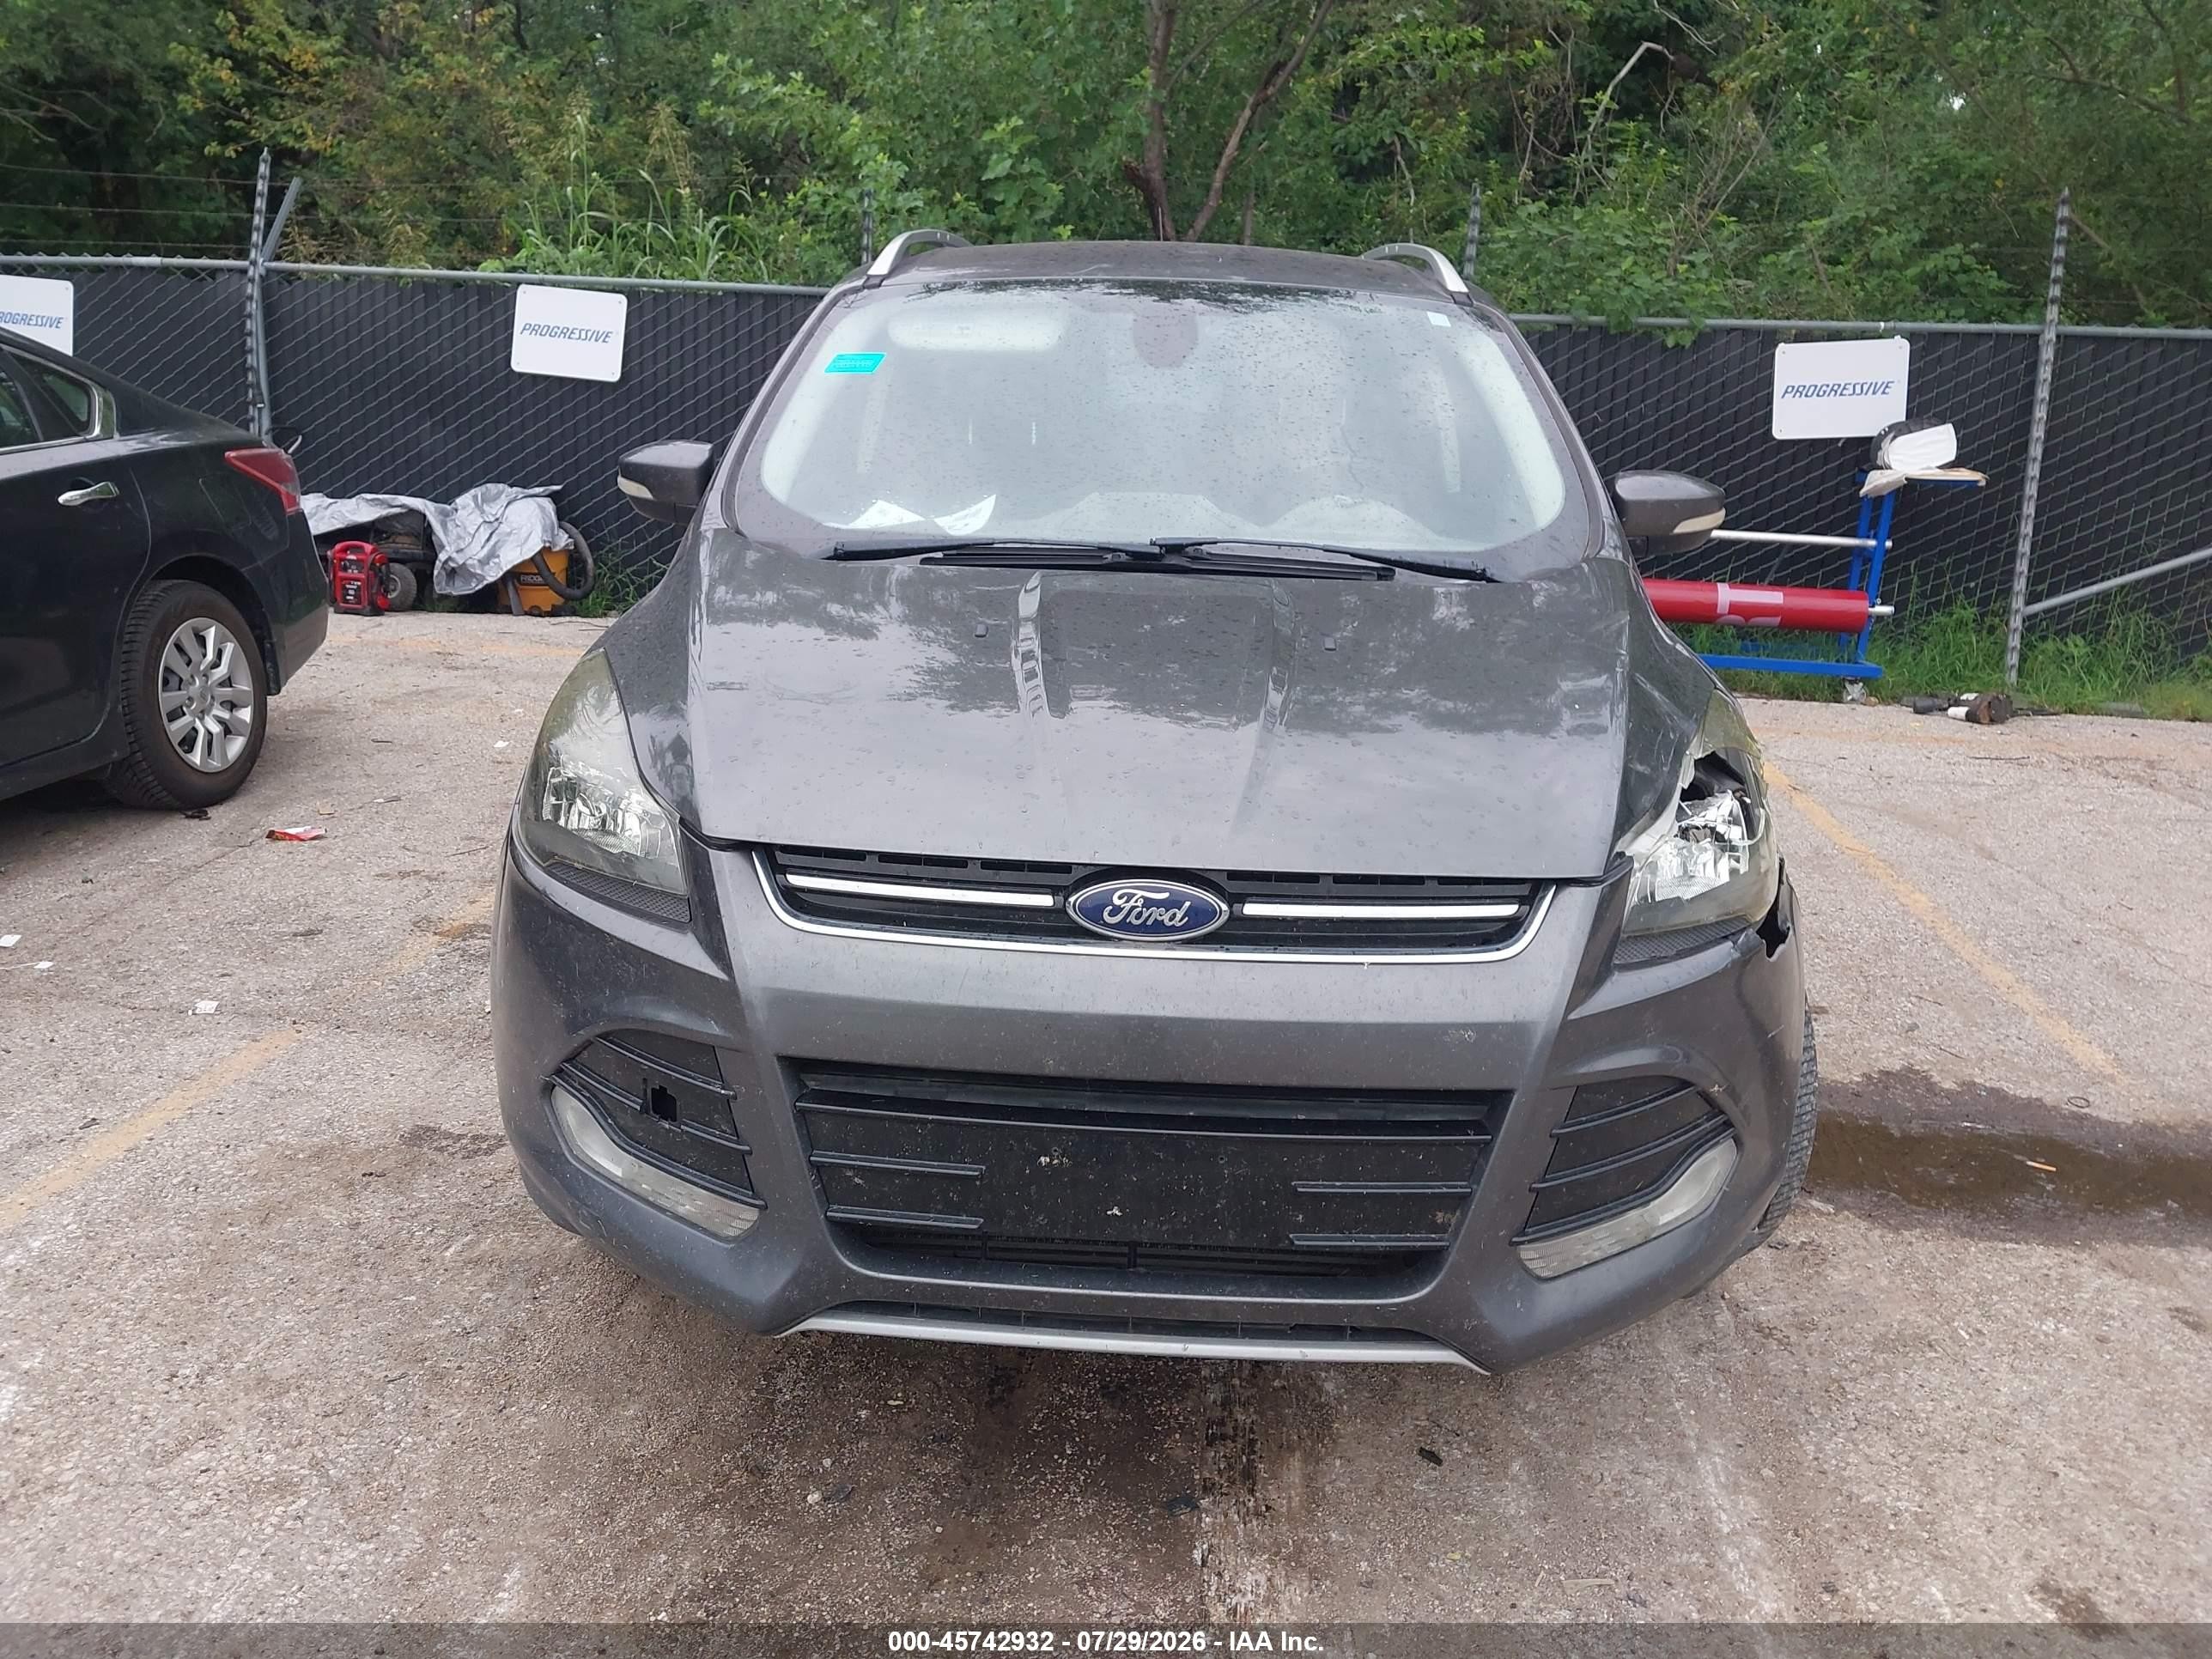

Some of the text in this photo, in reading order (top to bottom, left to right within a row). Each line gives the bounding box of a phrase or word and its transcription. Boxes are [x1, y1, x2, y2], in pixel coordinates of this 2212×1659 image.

[519, 322, 614, 343] PROGRESSIVE
[1780, 380, 1895, 399] PROGRESSIVE
[1103, 888, 1191, 927] Ford
